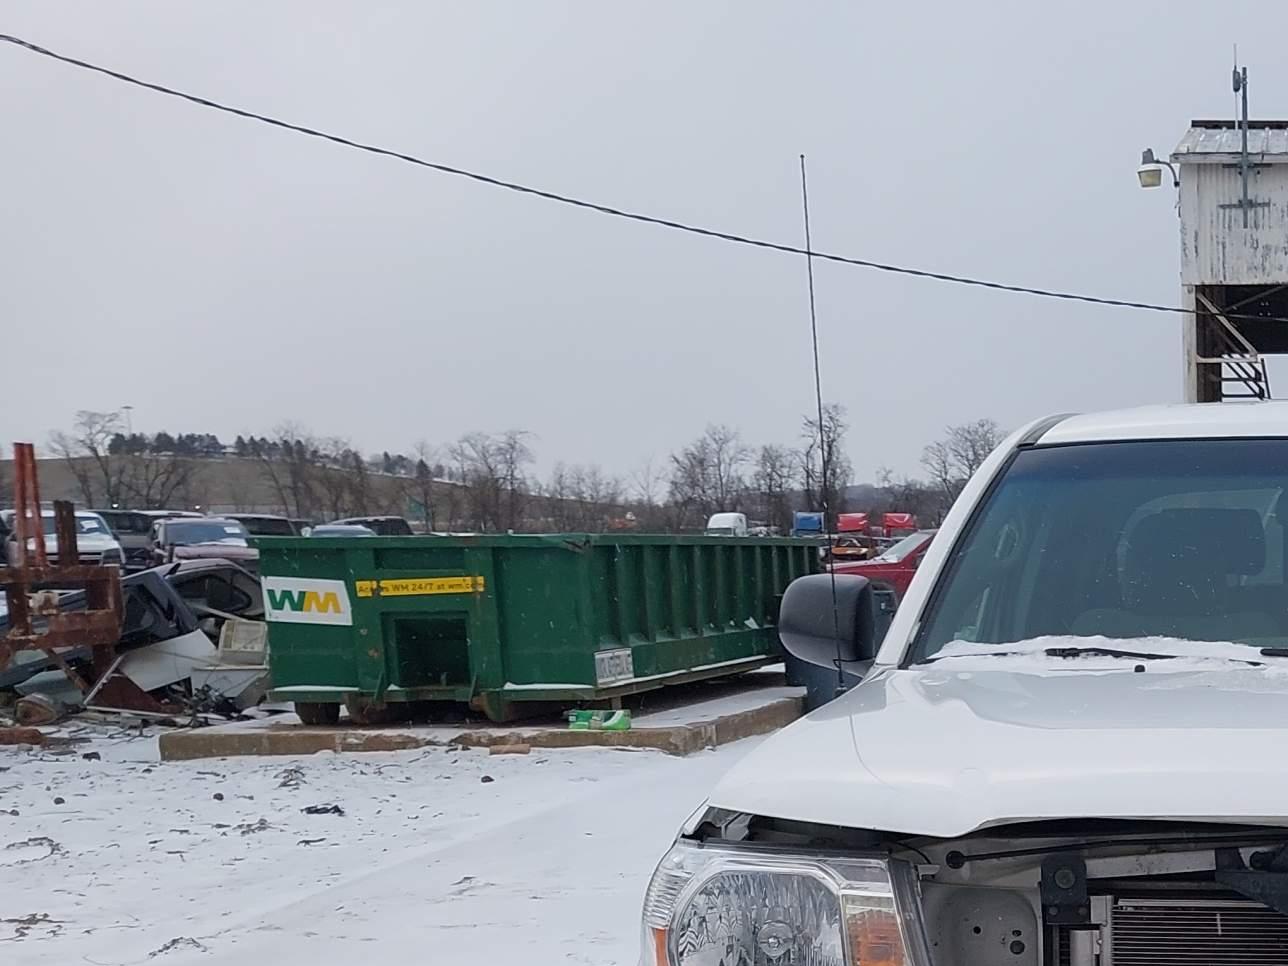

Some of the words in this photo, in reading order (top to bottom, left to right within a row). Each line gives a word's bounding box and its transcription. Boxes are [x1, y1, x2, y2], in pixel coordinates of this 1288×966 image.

[391, 583, 409, 592] WM
[411, 582, 433, 592] 24/7
[266, 588, 343, 614] WM
